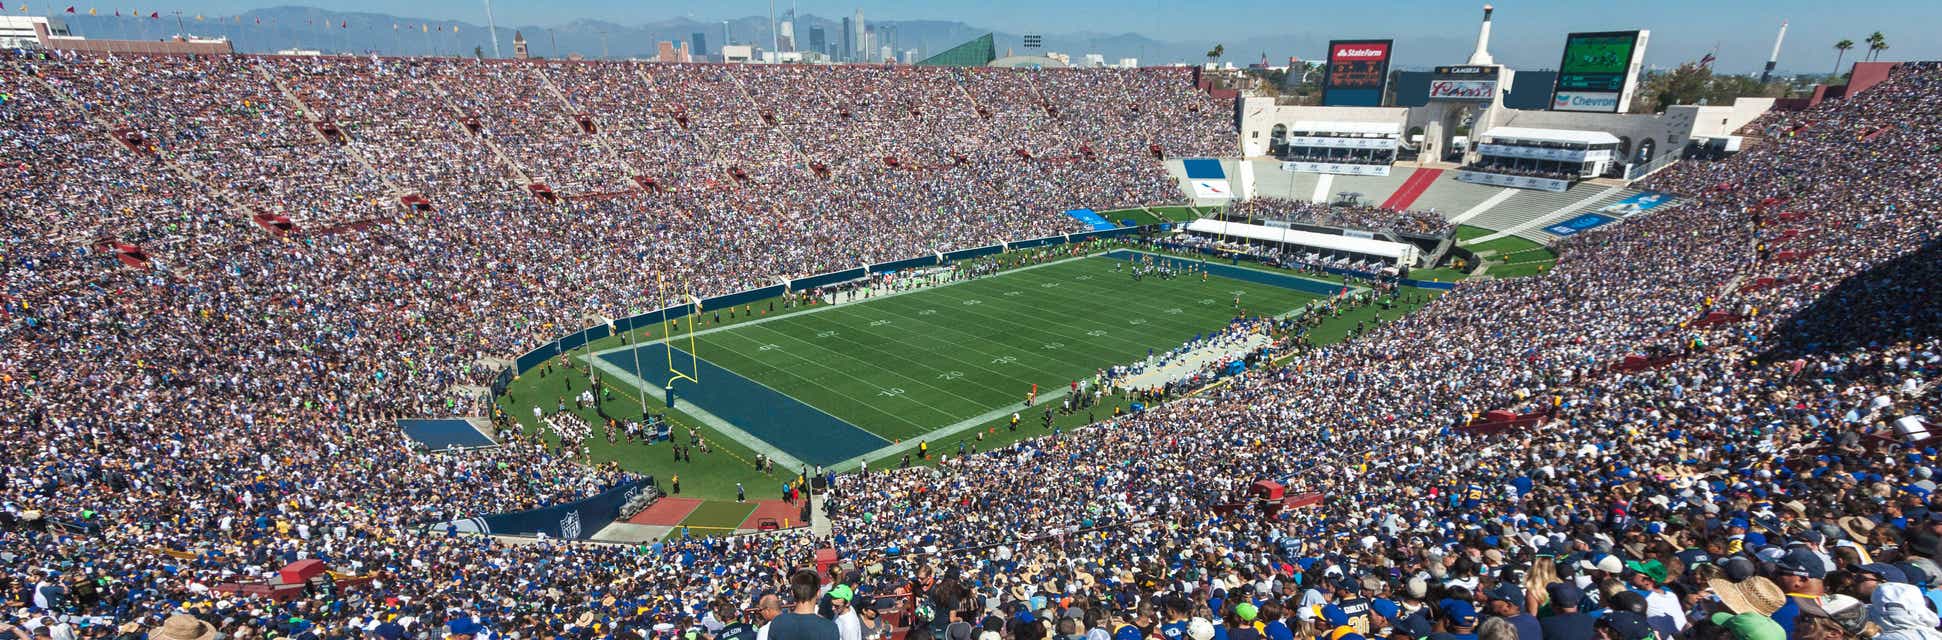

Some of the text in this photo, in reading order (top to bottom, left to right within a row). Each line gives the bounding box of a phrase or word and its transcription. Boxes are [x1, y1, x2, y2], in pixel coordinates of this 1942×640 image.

[1572, 95, 1617, 107] Chevron
[1286, 545, 1300, 559] 37
[208, 590, 221, 599] 12
[722, 627, 742, 638] WILSON
